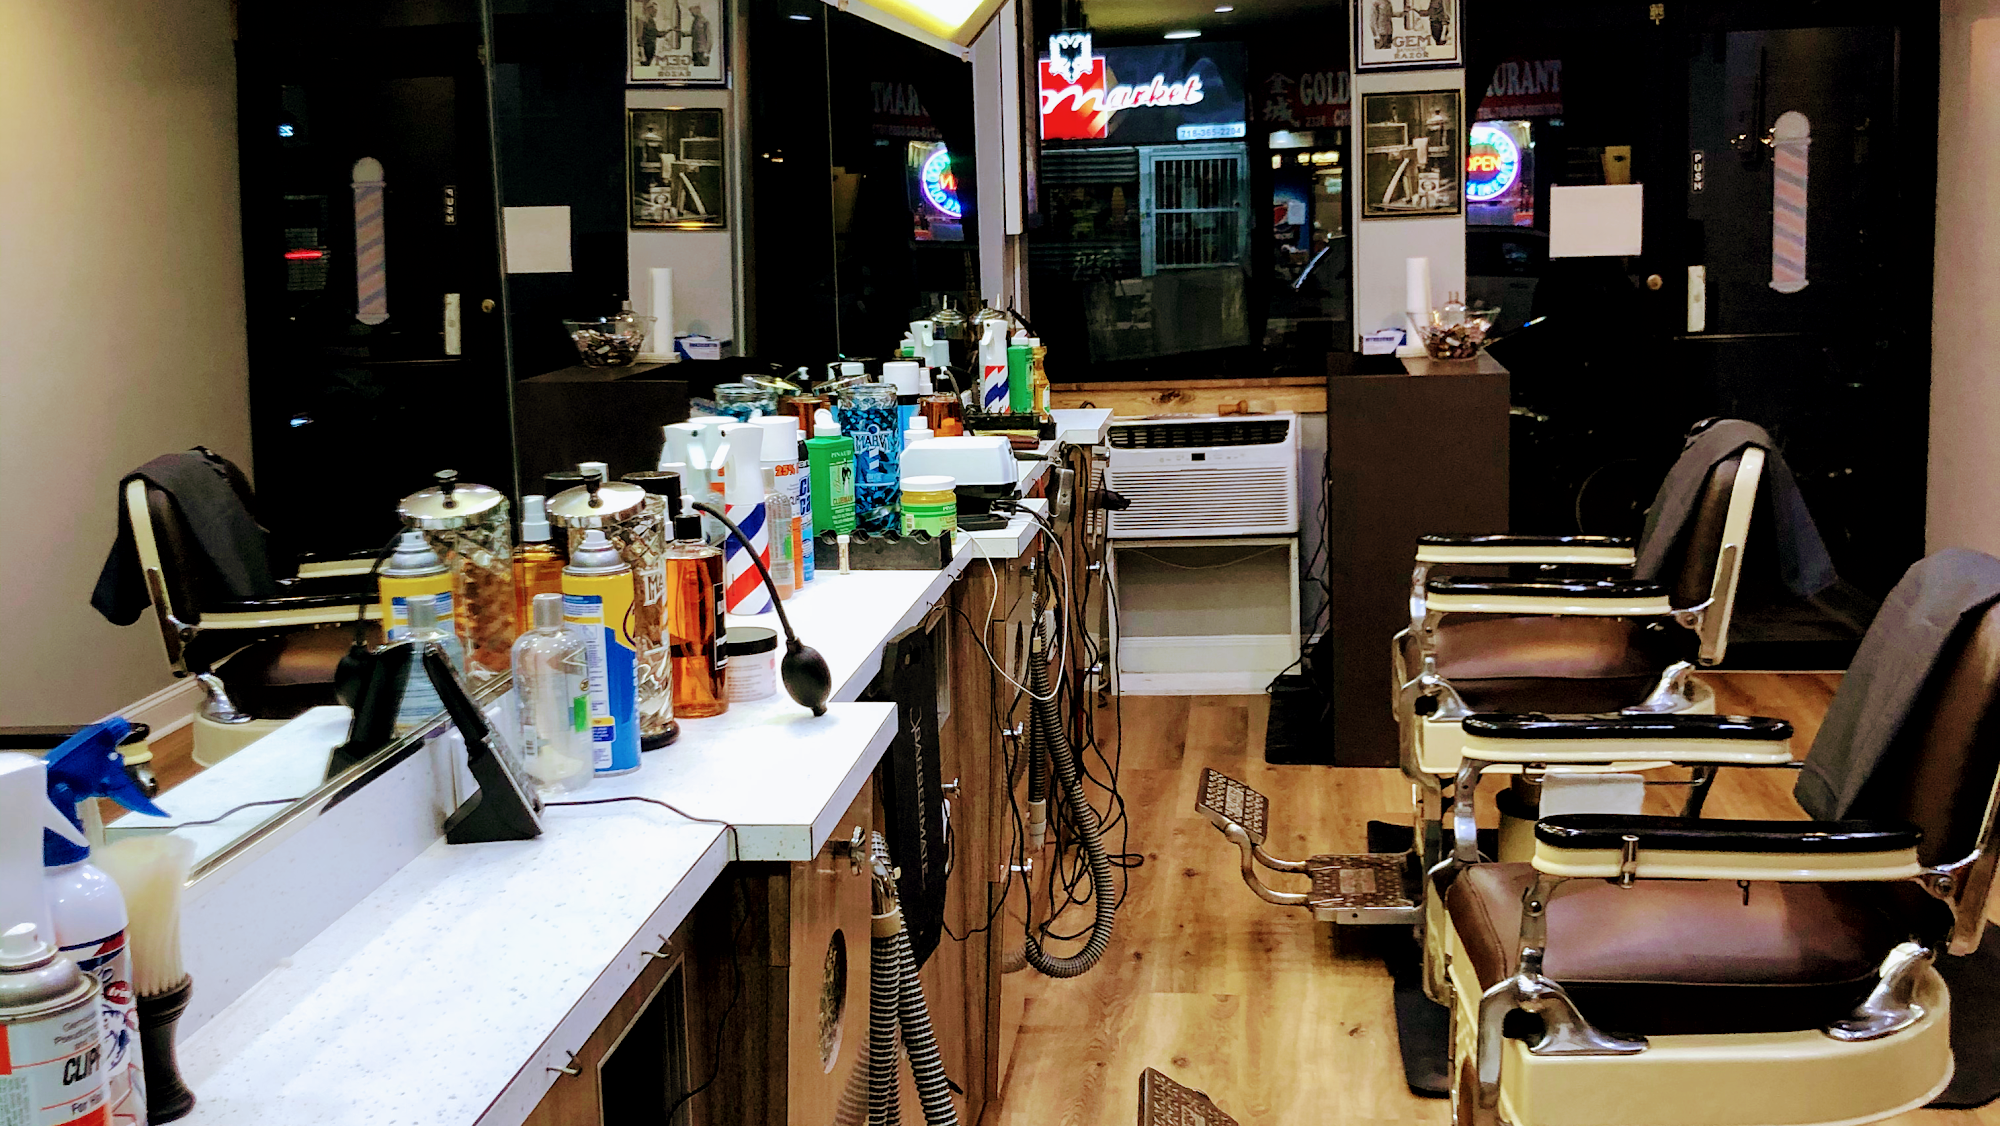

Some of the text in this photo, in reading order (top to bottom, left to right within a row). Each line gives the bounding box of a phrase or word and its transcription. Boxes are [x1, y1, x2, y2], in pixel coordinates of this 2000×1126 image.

[1393, 35, 1432, 48] GEM
[1394, 51, 1430, 60] RAZOR
[1693, 153, 1703, 191] PUSH
